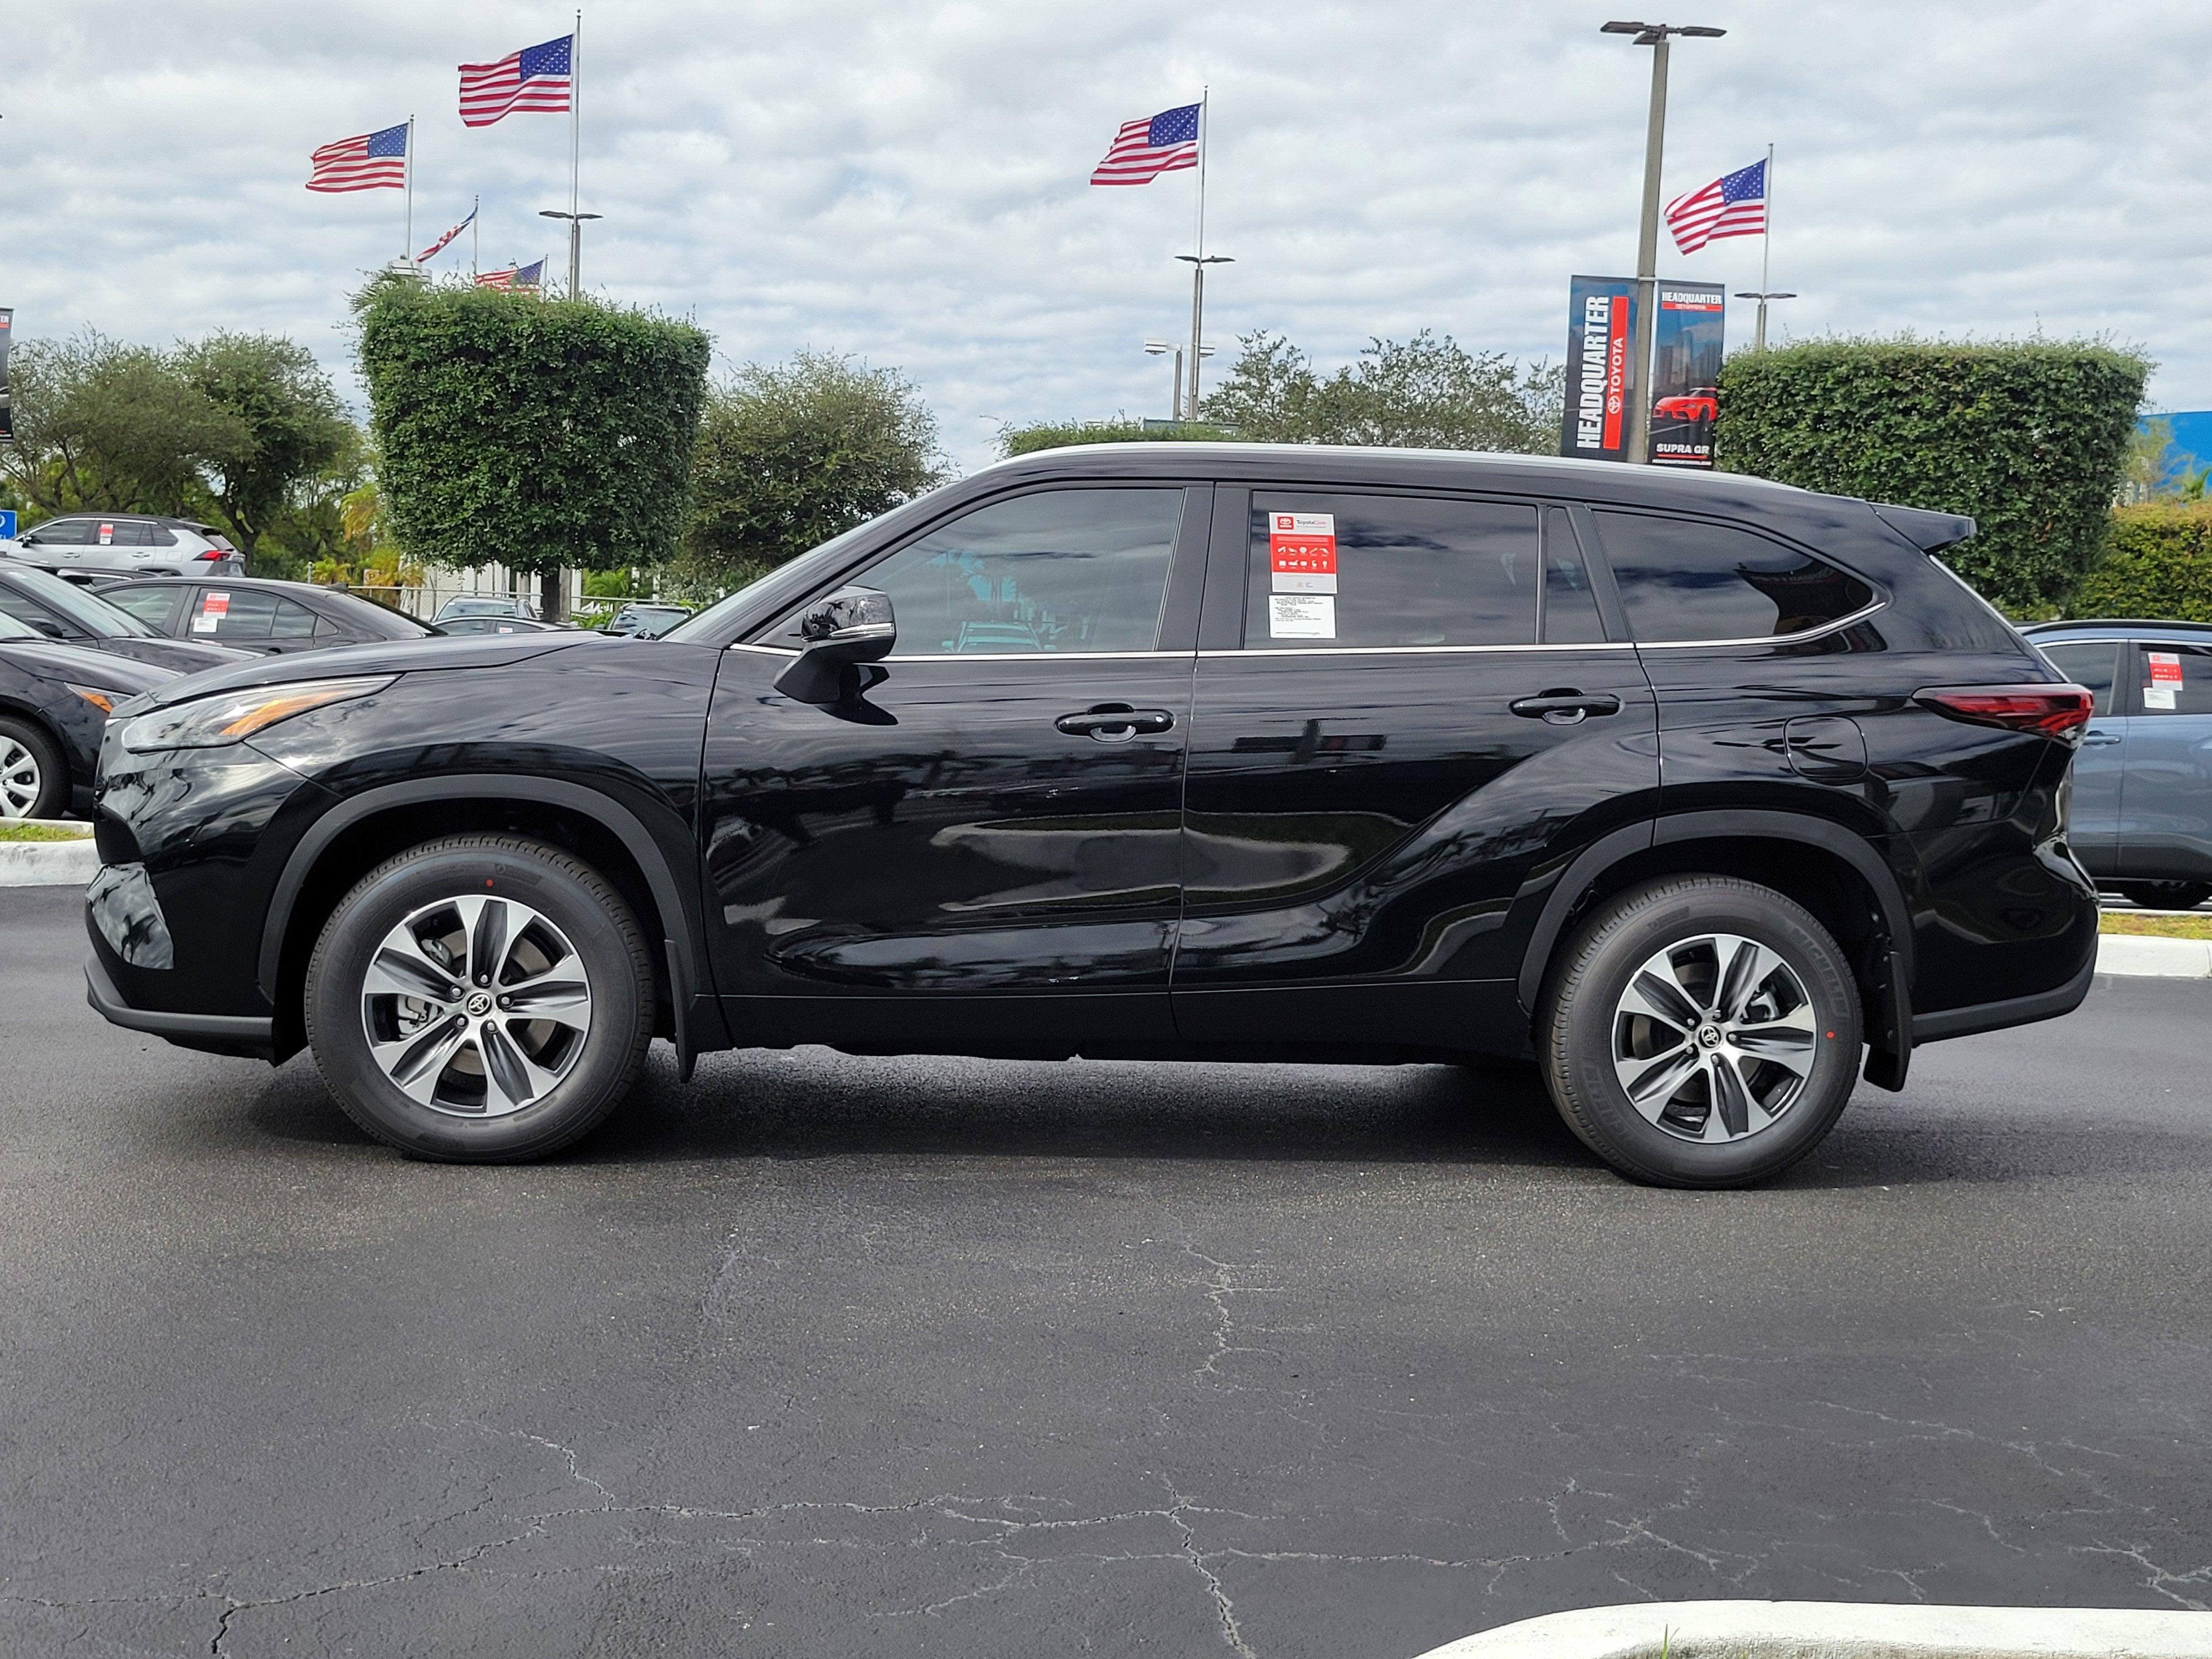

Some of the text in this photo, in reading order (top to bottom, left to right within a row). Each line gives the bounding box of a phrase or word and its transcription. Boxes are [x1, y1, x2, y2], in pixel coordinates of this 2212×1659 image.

[1662, 291, 1722, 304] HEADQUARTER
[1576, 296, 1609, 449] HEADQUARTER
[1610, 337, 1624, 395] TOYOTA
[1656, 443, 1709, 454] SUPRA GR
